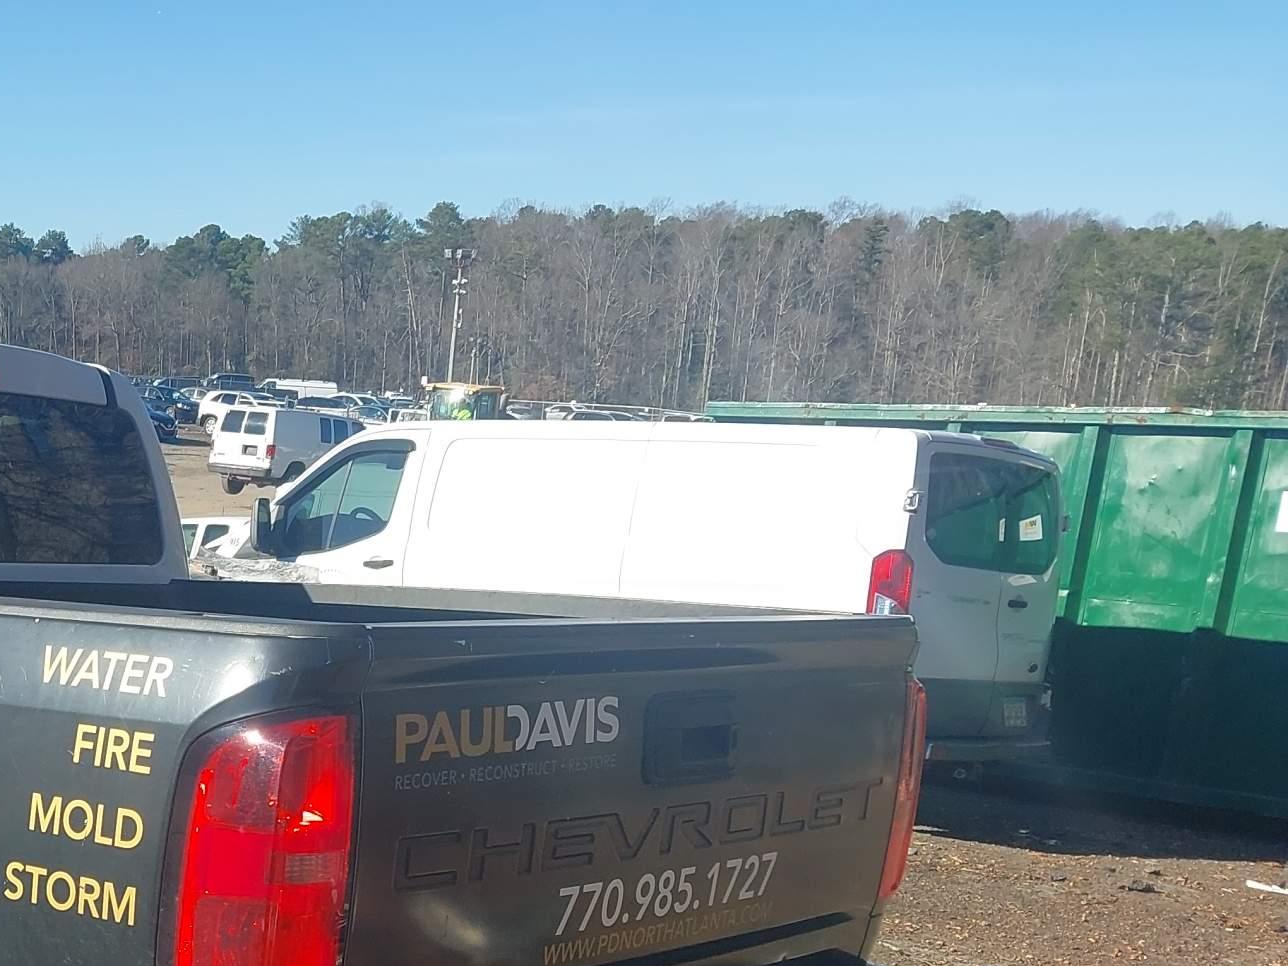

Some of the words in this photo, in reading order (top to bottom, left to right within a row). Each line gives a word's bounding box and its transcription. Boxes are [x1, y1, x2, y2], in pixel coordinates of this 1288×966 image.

[42, 645, 173, 697] WATER
[72, 723, 156, 774] FIRE
[395, 771, 457, 790] RECOVER
[469, 761, 557, 783] RECONSTRUCT
[28, 792, 143, 849] MOLD
[391, 777, 884, 891] CHEVROLET
[3, 862, 137, 927] STORM
[554, 852, 778, 936] 770.985.1727
